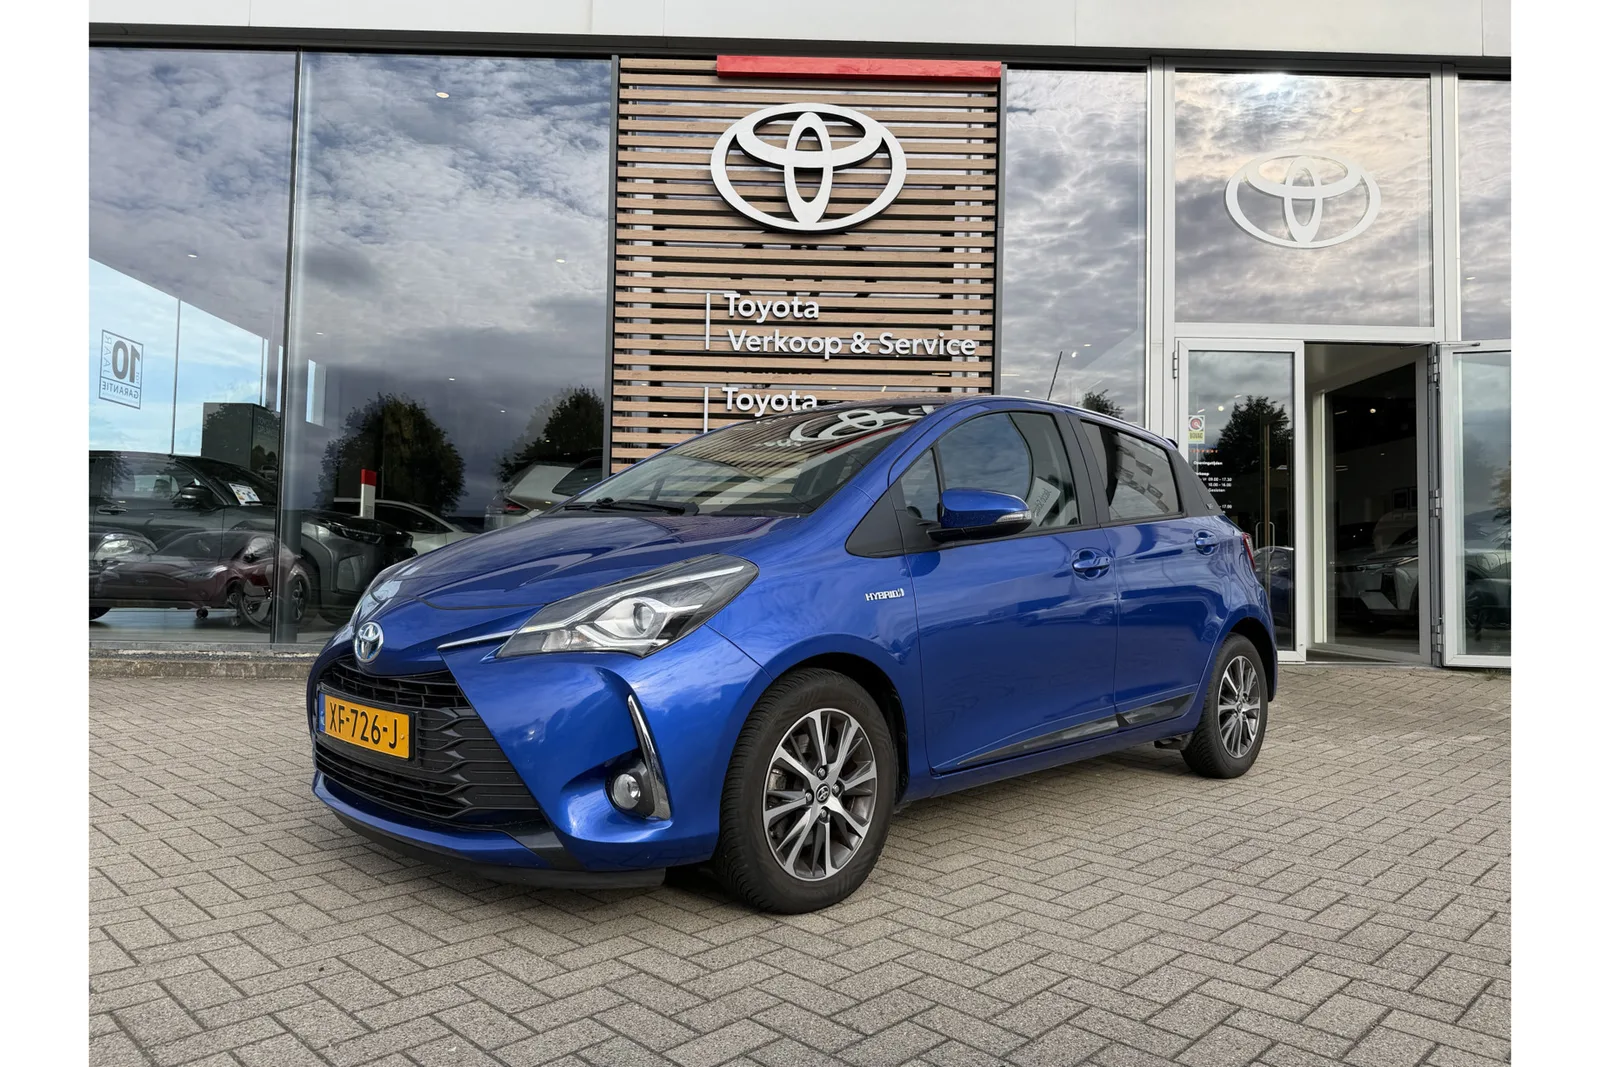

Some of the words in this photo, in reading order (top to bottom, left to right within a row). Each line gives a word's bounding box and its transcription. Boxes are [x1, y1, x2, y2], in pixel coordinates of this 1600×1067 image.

[724, 293, 819, 323] Toyota
[728, 329, 842, 360] Verkoop
[850, 331, 870, 354] &
[879, 331, 977, 355] Service
[722, 387, 818, 417] Toyota
[329, 702, 398, 750] XF-726-J
